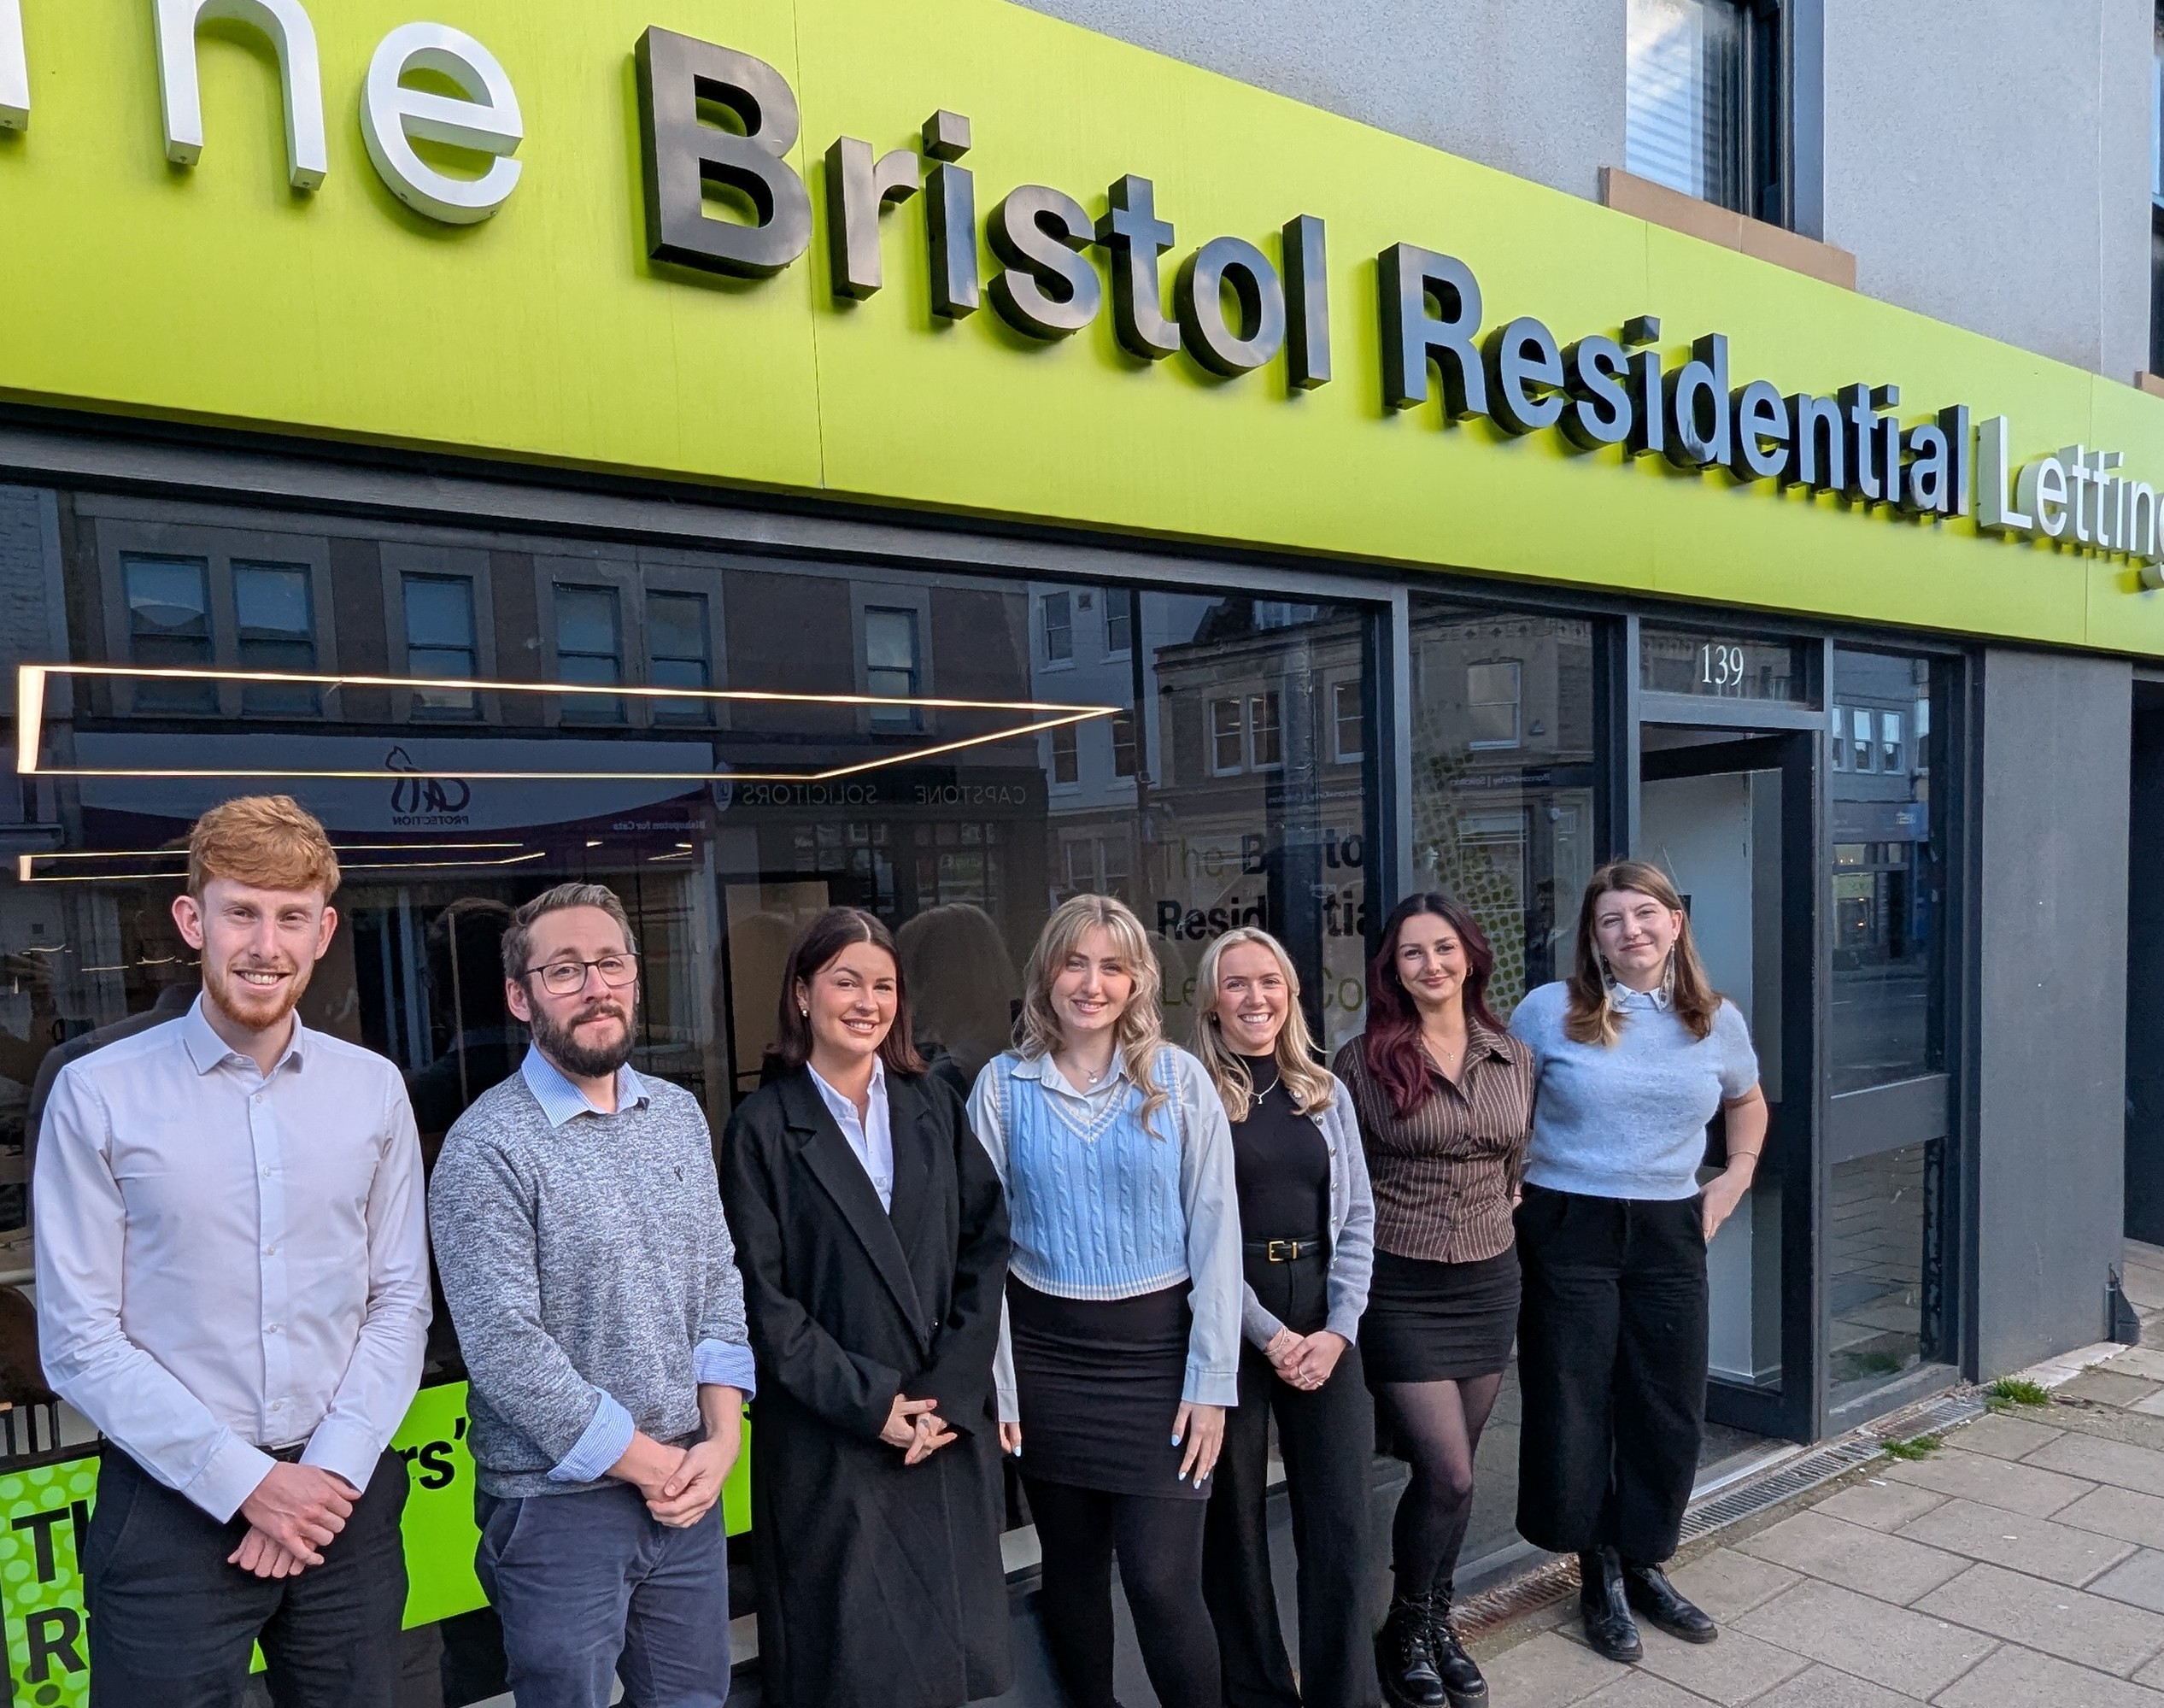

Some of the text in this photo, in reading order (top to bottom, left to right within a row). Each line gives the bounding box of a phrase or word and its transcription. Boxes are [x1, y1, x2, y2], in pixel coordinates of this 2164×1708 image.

[0, 0, 2164, 589] he Bristol Residential Lettin
[1702, 643, 1745, 687] 139
